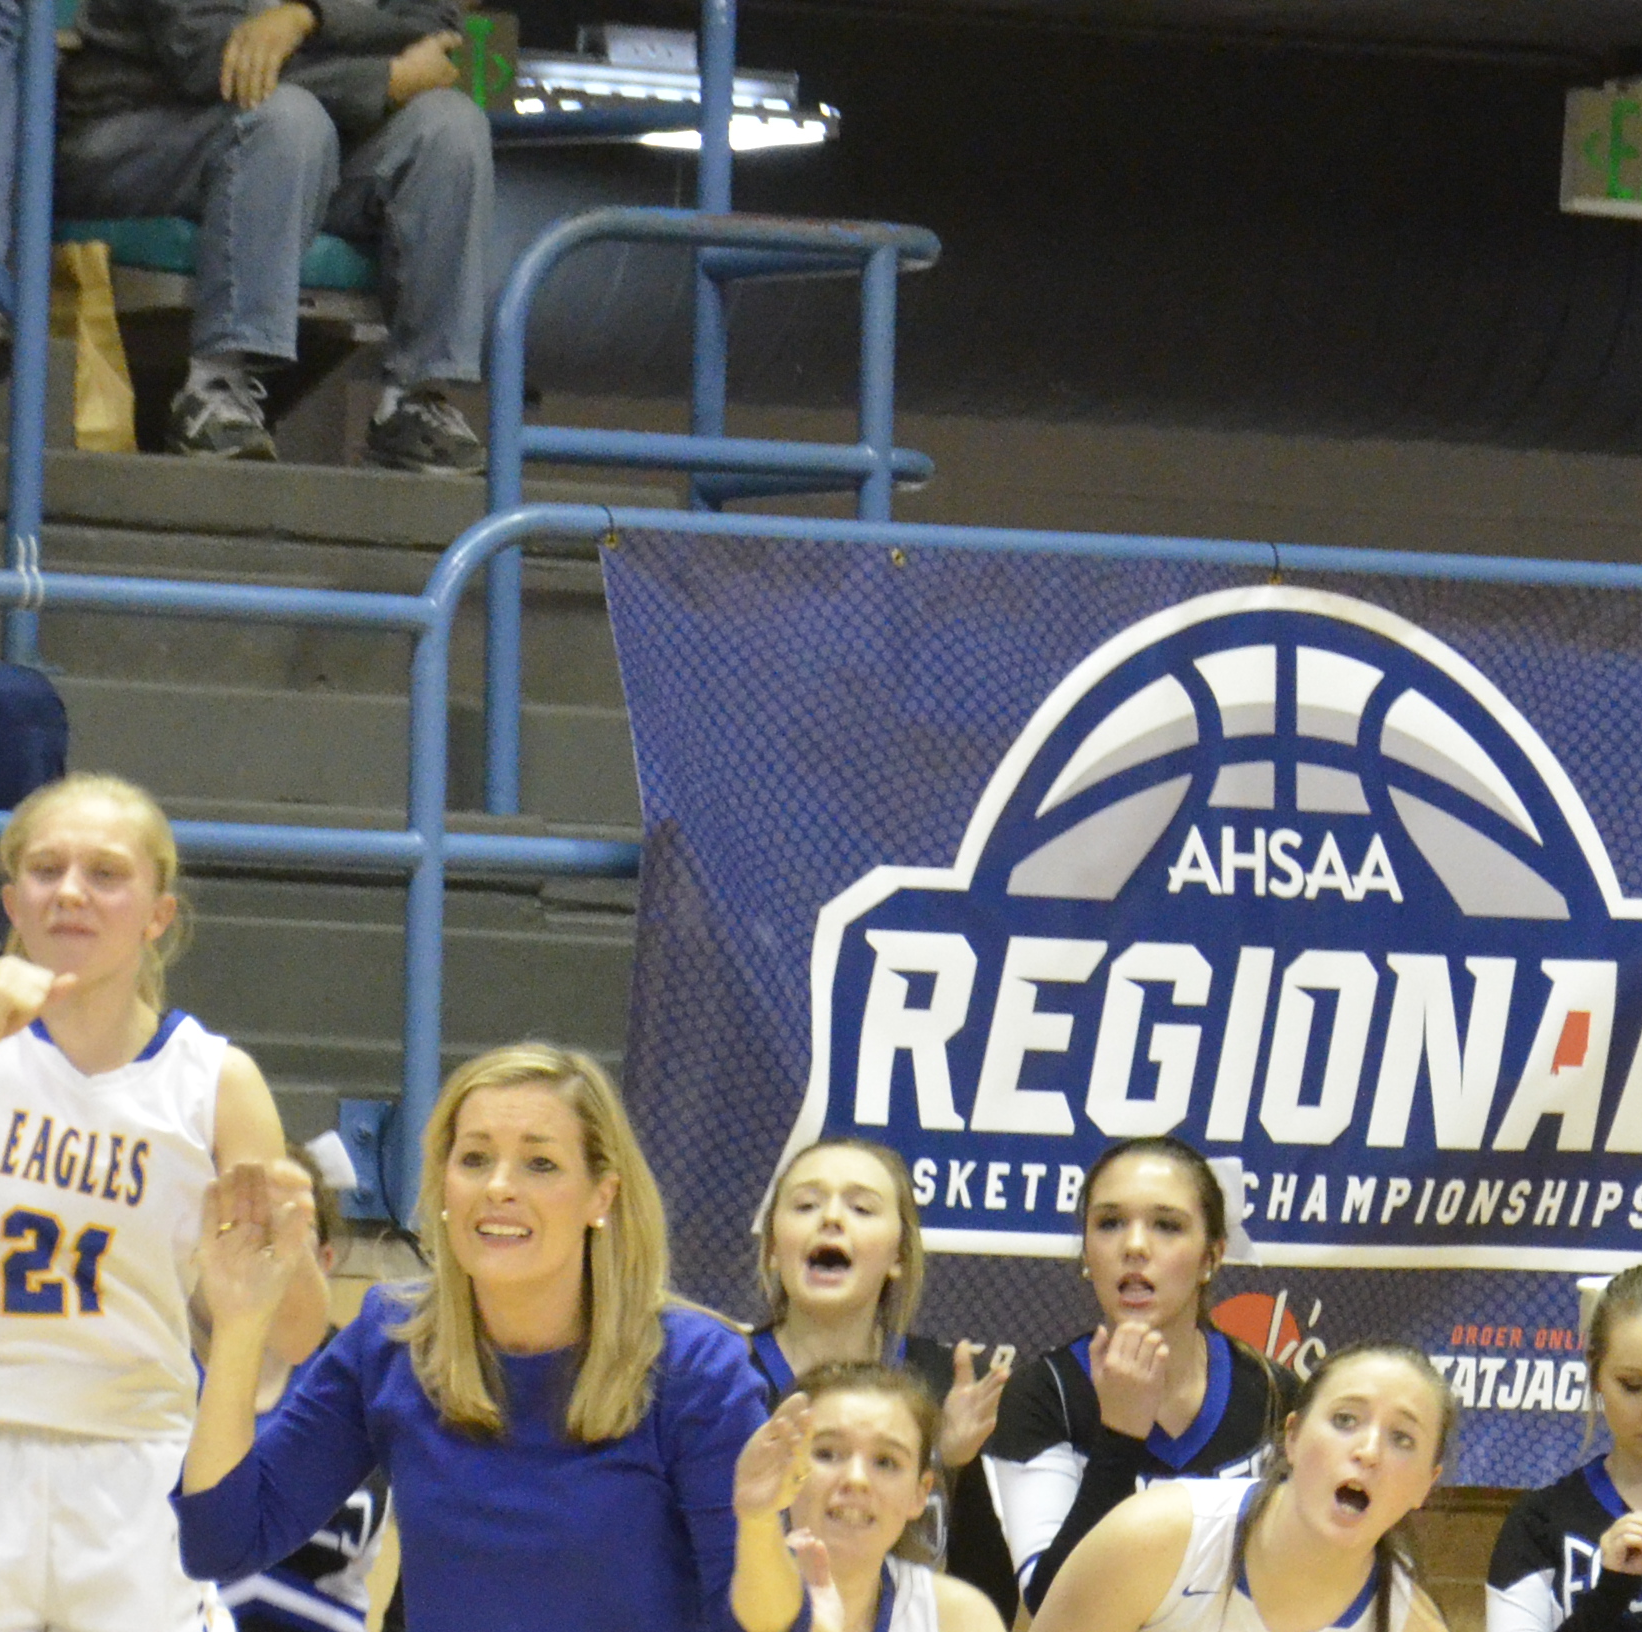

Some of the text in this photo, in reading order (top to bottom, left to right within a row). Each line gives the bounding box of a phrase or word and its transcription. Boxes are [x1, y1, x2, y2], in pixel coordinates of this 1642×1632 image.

[1167, 824, 1404, 904] AHSAA
[913, 1157, 1086, 1213] SKETB
[0, 1204, 117, 1318] 21
[1451, 1325, 1524, 1348] ORDER
